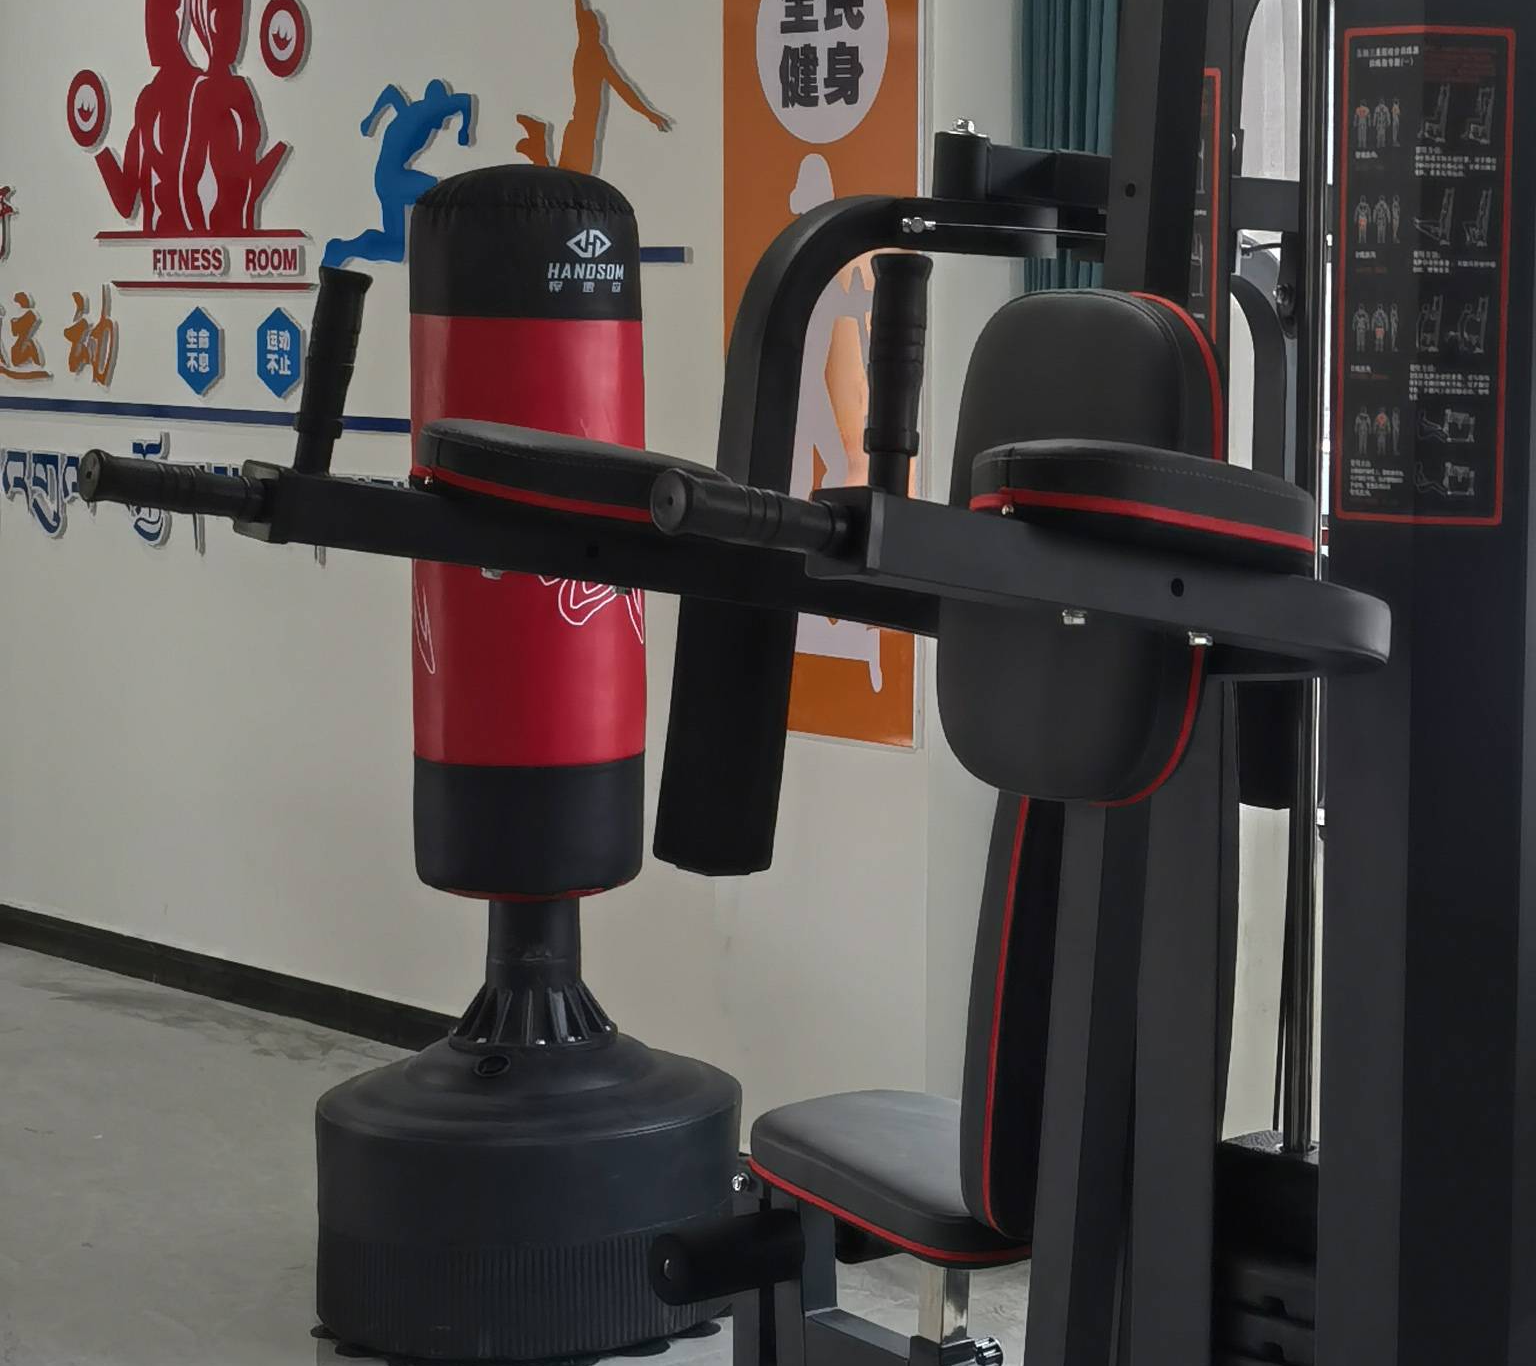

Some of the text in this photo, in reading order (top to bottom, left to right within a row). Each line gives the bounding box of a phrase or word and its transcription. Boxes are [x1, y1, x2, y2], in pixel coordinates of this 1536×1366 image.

[778, 41, 864, 108] 健身
[152, 248, 298, 272] FITNESS ROOM
[547, 262, 625, 280] HANDSOM
[186, 327, 210, 349] 生命
[266, 330, 291, 351] 运动
[186, 351, 210, 373] 不息
[266, 353, 292, 375] 不止
